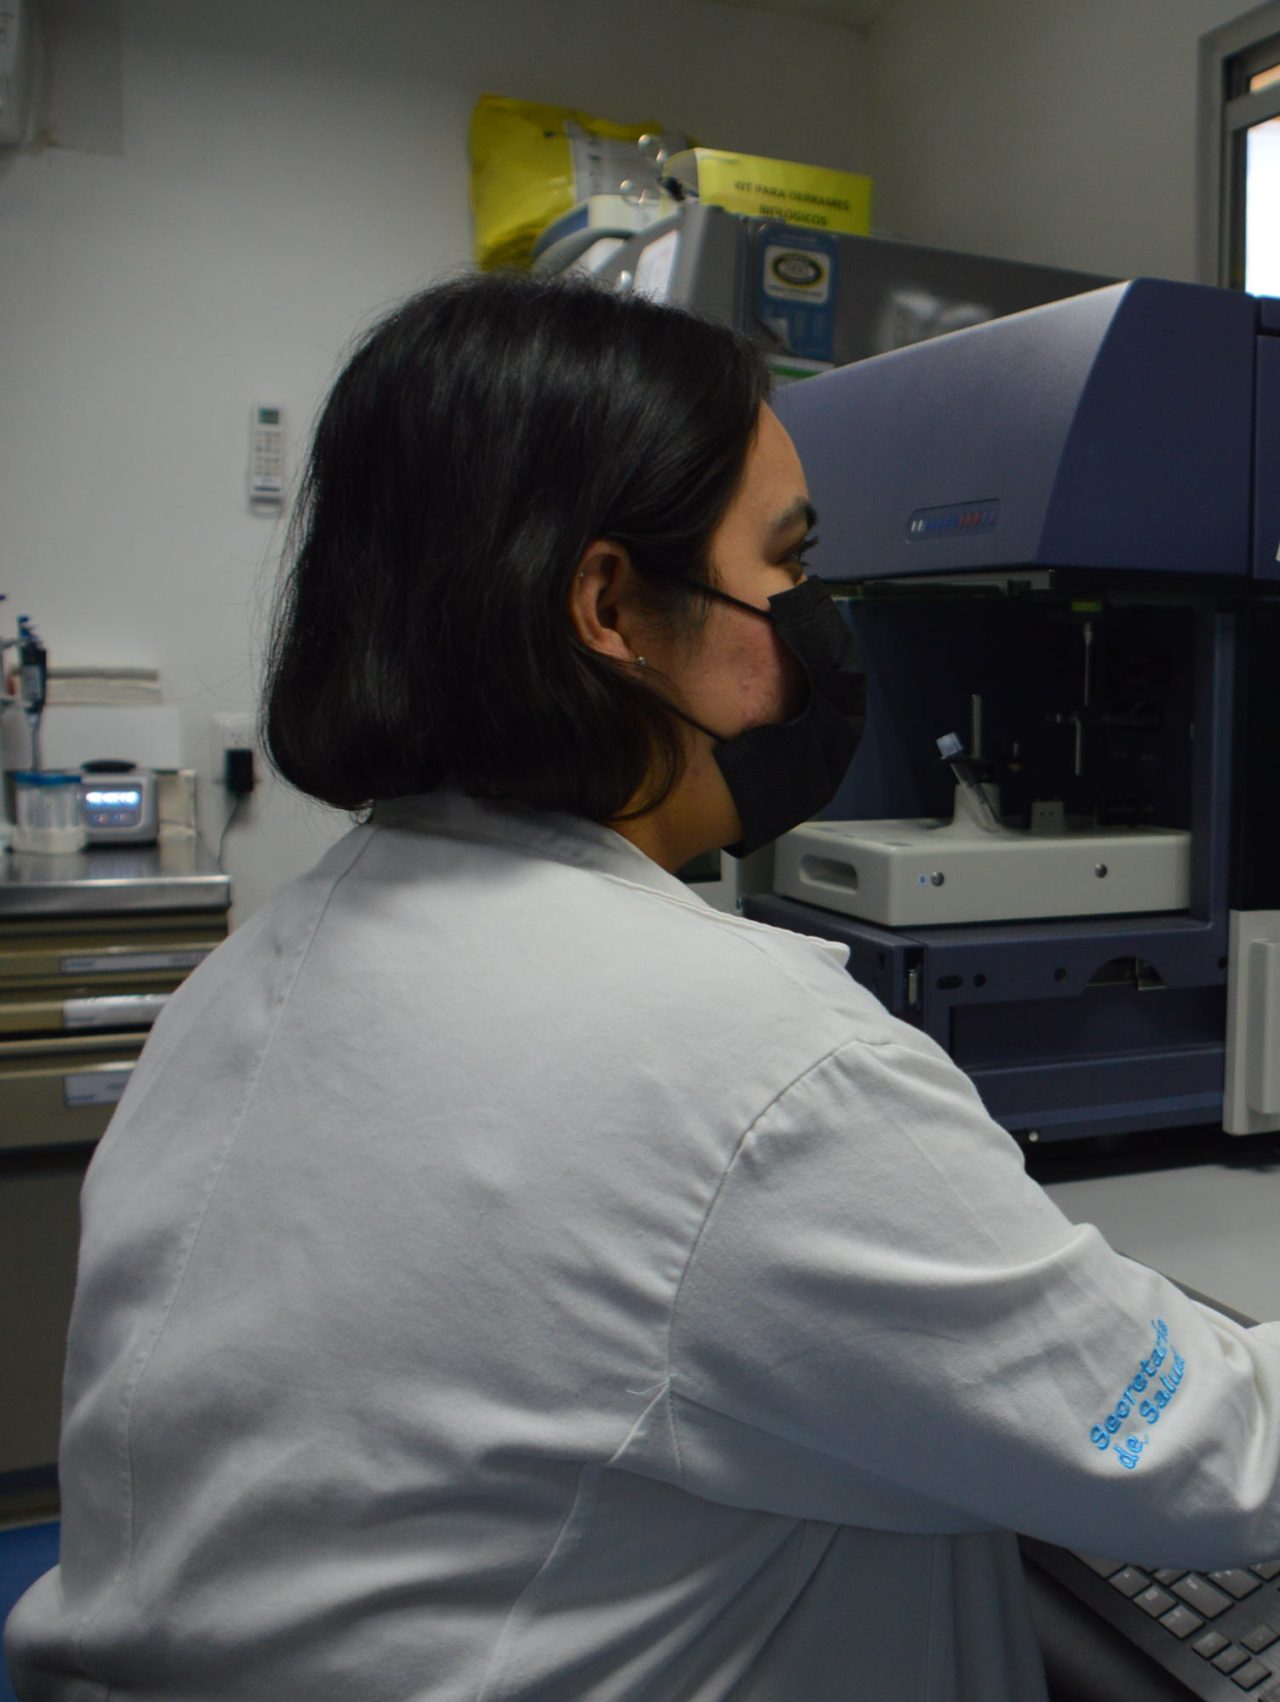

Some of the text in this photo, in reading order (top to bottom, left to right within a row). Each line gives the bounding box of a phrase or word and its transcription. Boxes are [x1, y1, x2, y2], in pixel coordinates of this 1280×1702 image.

[734, 181, 850, 211] KIT PARA DERRAMES
[1113, 1434, 1144, 1470] de
